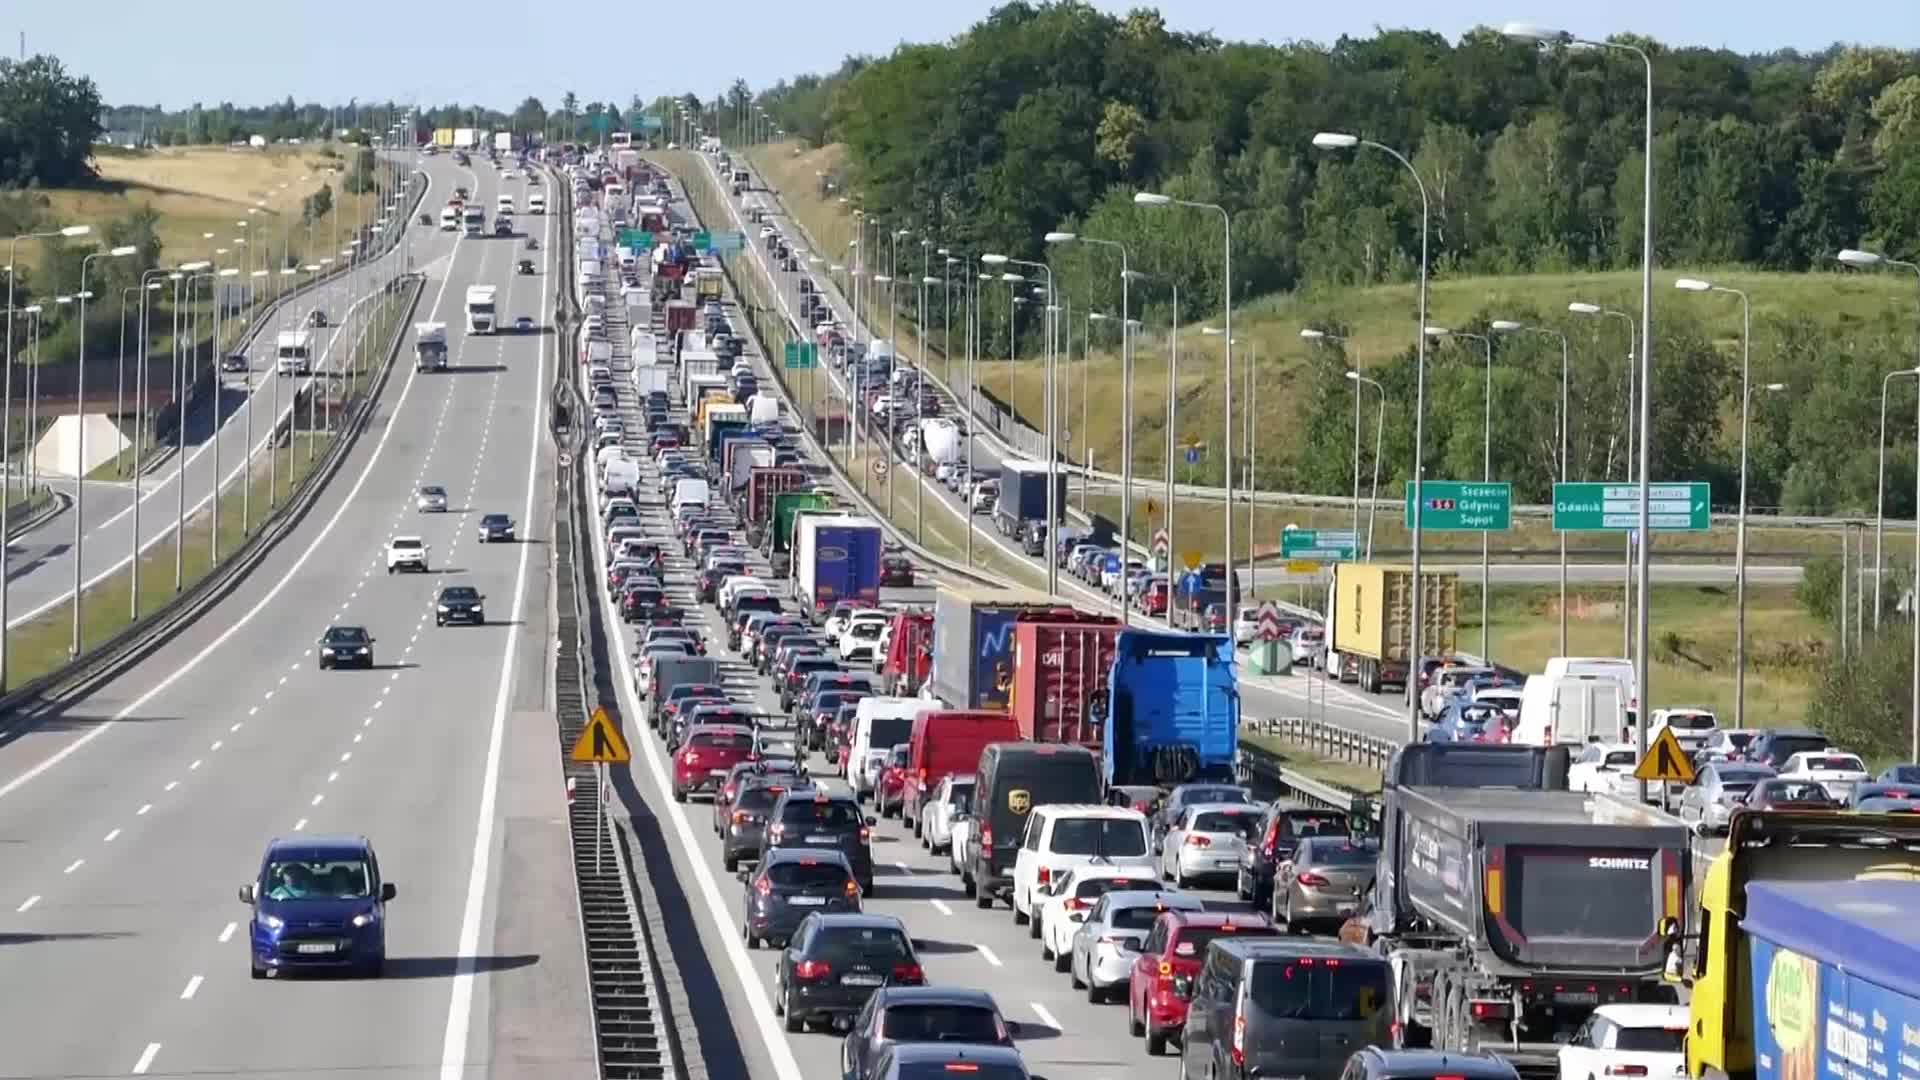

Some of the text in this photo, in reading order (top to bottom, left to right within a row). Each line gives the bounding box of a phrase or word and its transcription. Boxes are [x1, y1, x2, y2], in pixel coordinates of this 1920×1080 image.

[1459, 499, 1501, 512] Gdynia
[1460, 514, 1494, 527] Sopot
[1589, 857, 1649, 869] SCHMITZ
